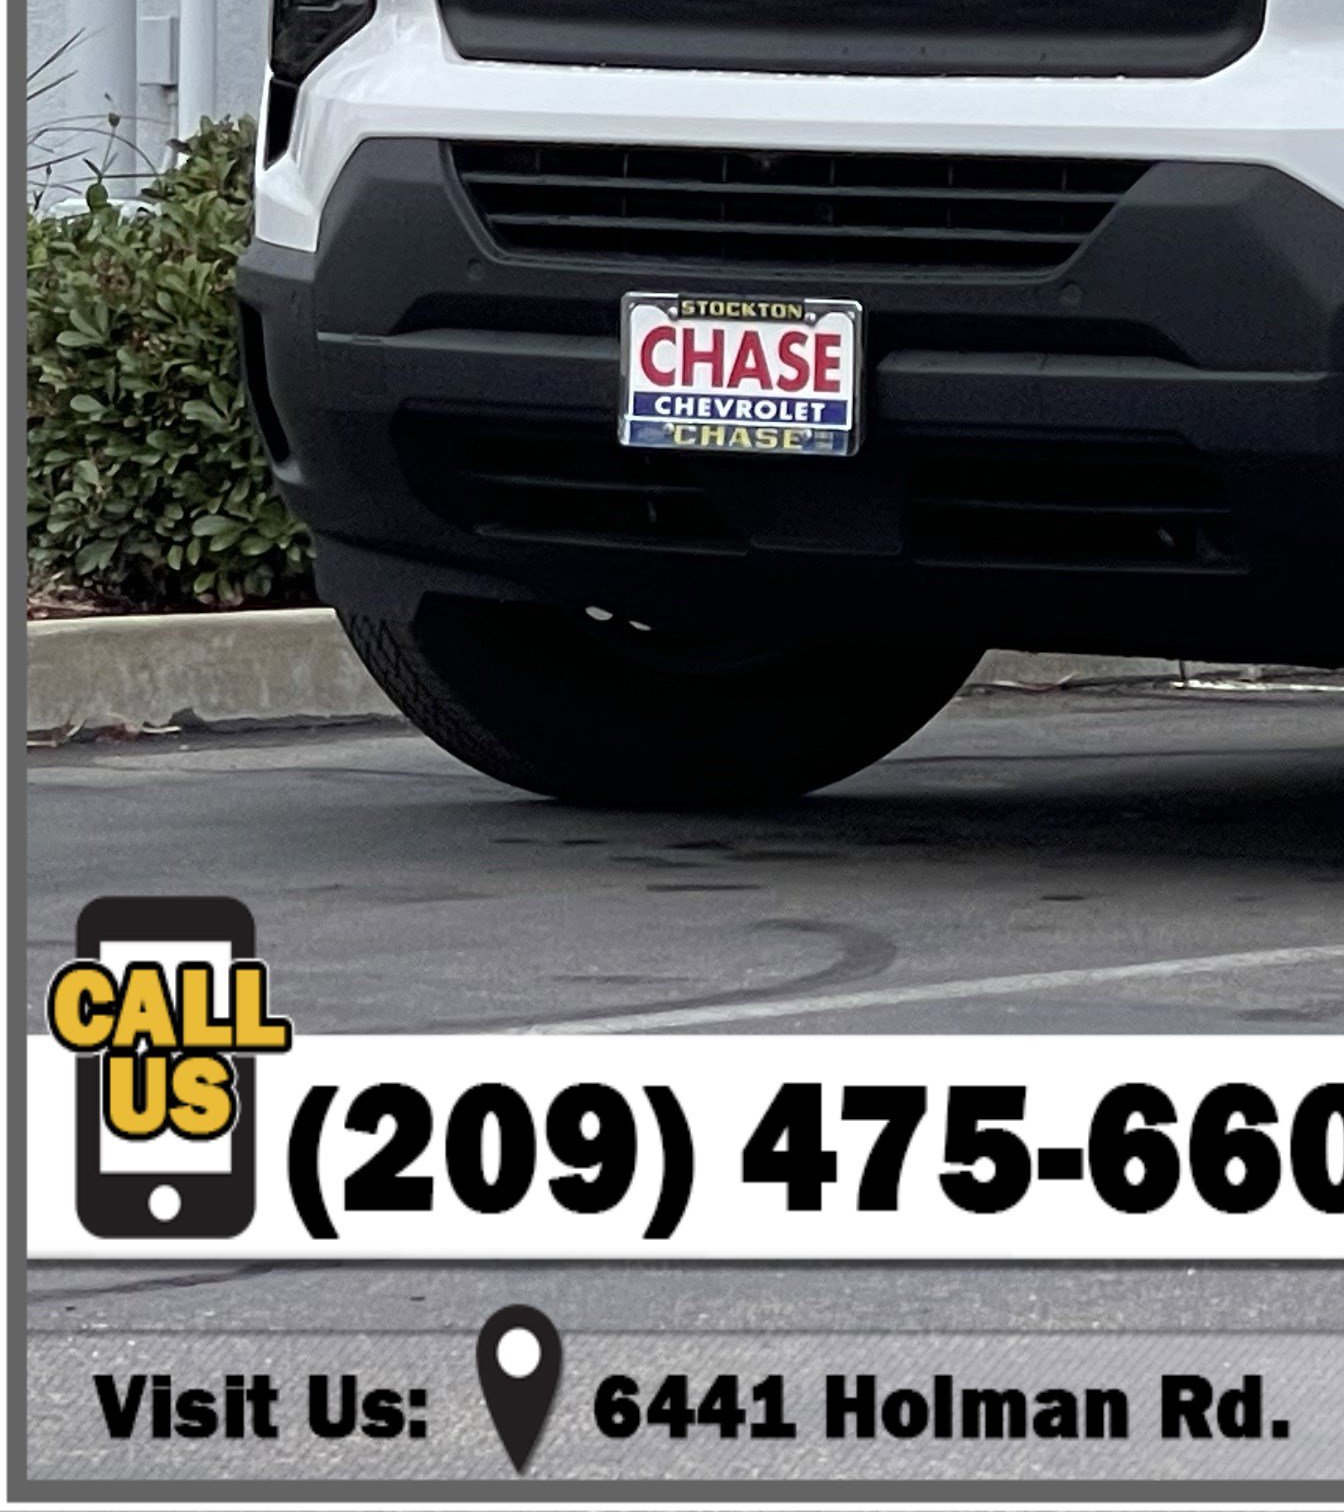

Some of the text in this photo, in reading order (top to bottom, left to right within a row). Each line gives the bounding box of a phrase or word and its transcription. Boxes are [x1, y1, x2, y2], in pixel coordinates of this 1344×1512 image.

[681, 299, 803, 319] STOCKTON
[640, 325, 841, 393] CHASE
[654, 396, 825, 422] CHEVROLET
[674, 424, 804, 449] CHASE
